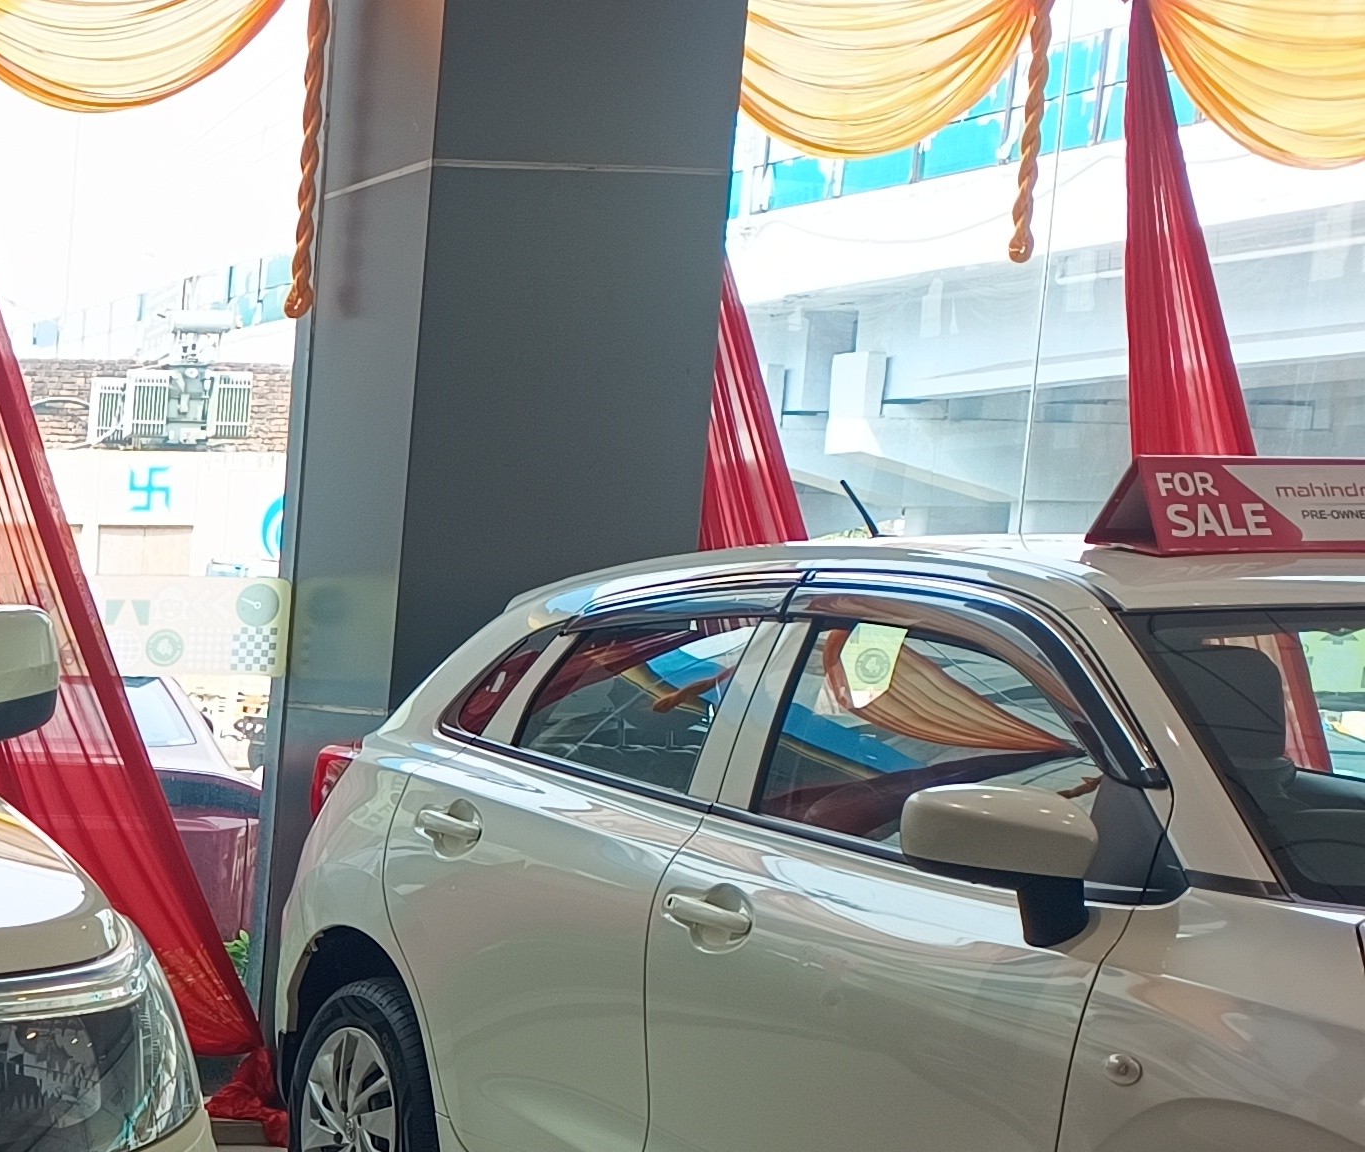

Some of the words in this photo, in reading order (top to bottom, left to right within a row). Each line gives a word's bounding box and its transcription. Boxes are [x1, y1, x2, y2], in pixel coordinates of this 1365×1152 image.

[1155, 471, 1220, 497] FOR
[1166, 503, 1273, 538] SALE
[1301, 509, 1365, 520] PRE-OWNE
